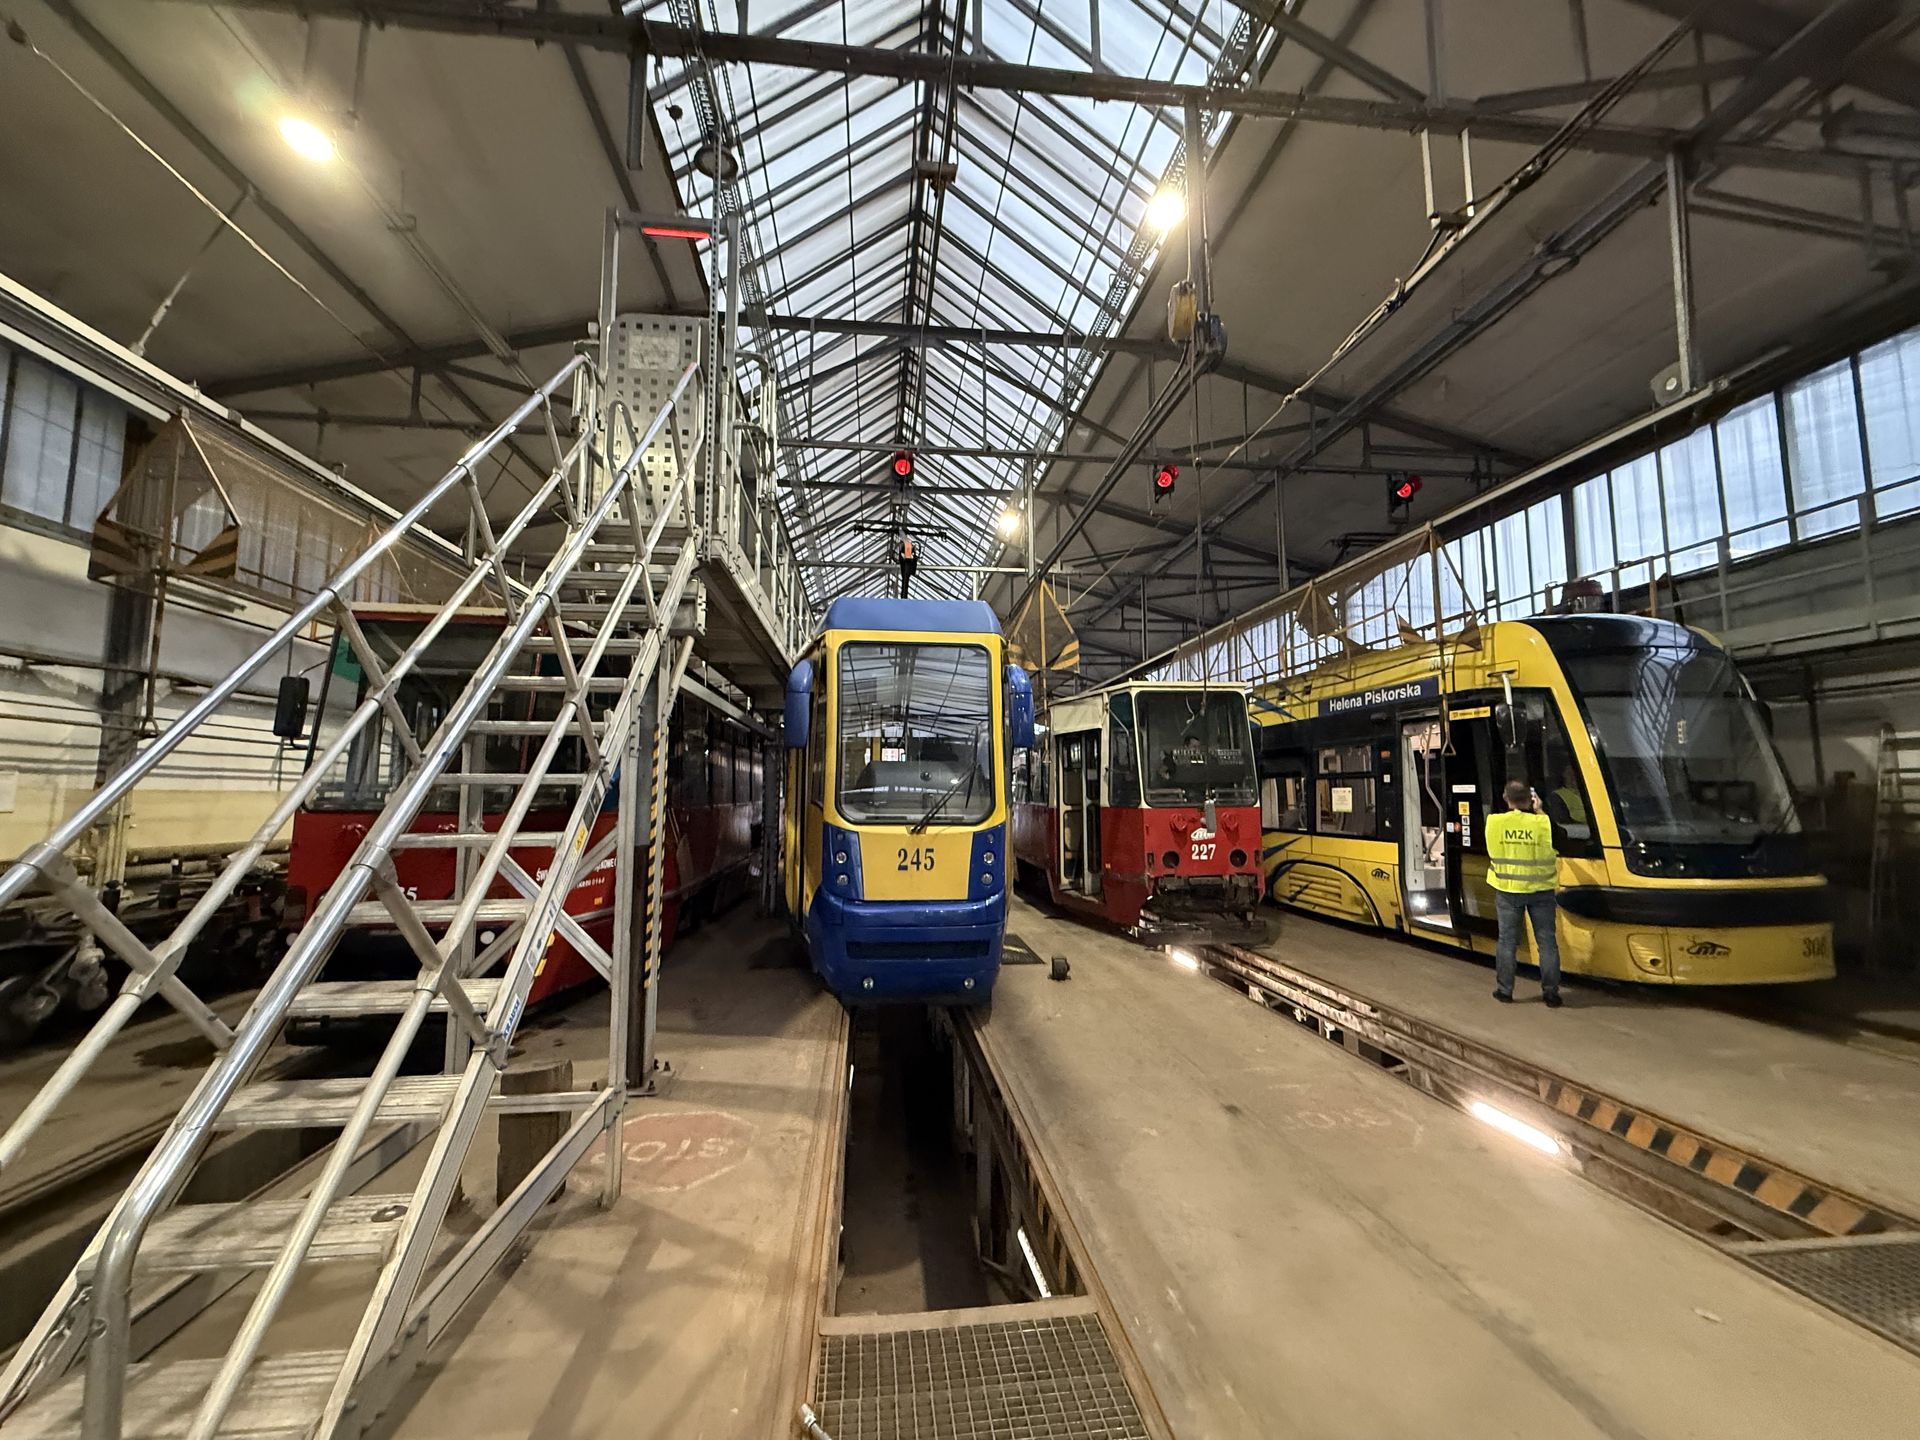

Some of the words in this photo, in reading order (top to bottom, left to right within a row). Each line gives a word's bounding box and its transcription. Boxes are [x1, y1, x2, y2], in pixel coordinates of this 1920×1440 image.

[1329, 697, 1362, 712] Helena
[1365, 683, 1421, 706] Piskorska
[1504, 829, 1533, 841] MZK
[897, 847, 935, 871] 245
[1191, 843, 1217, 860] 227
